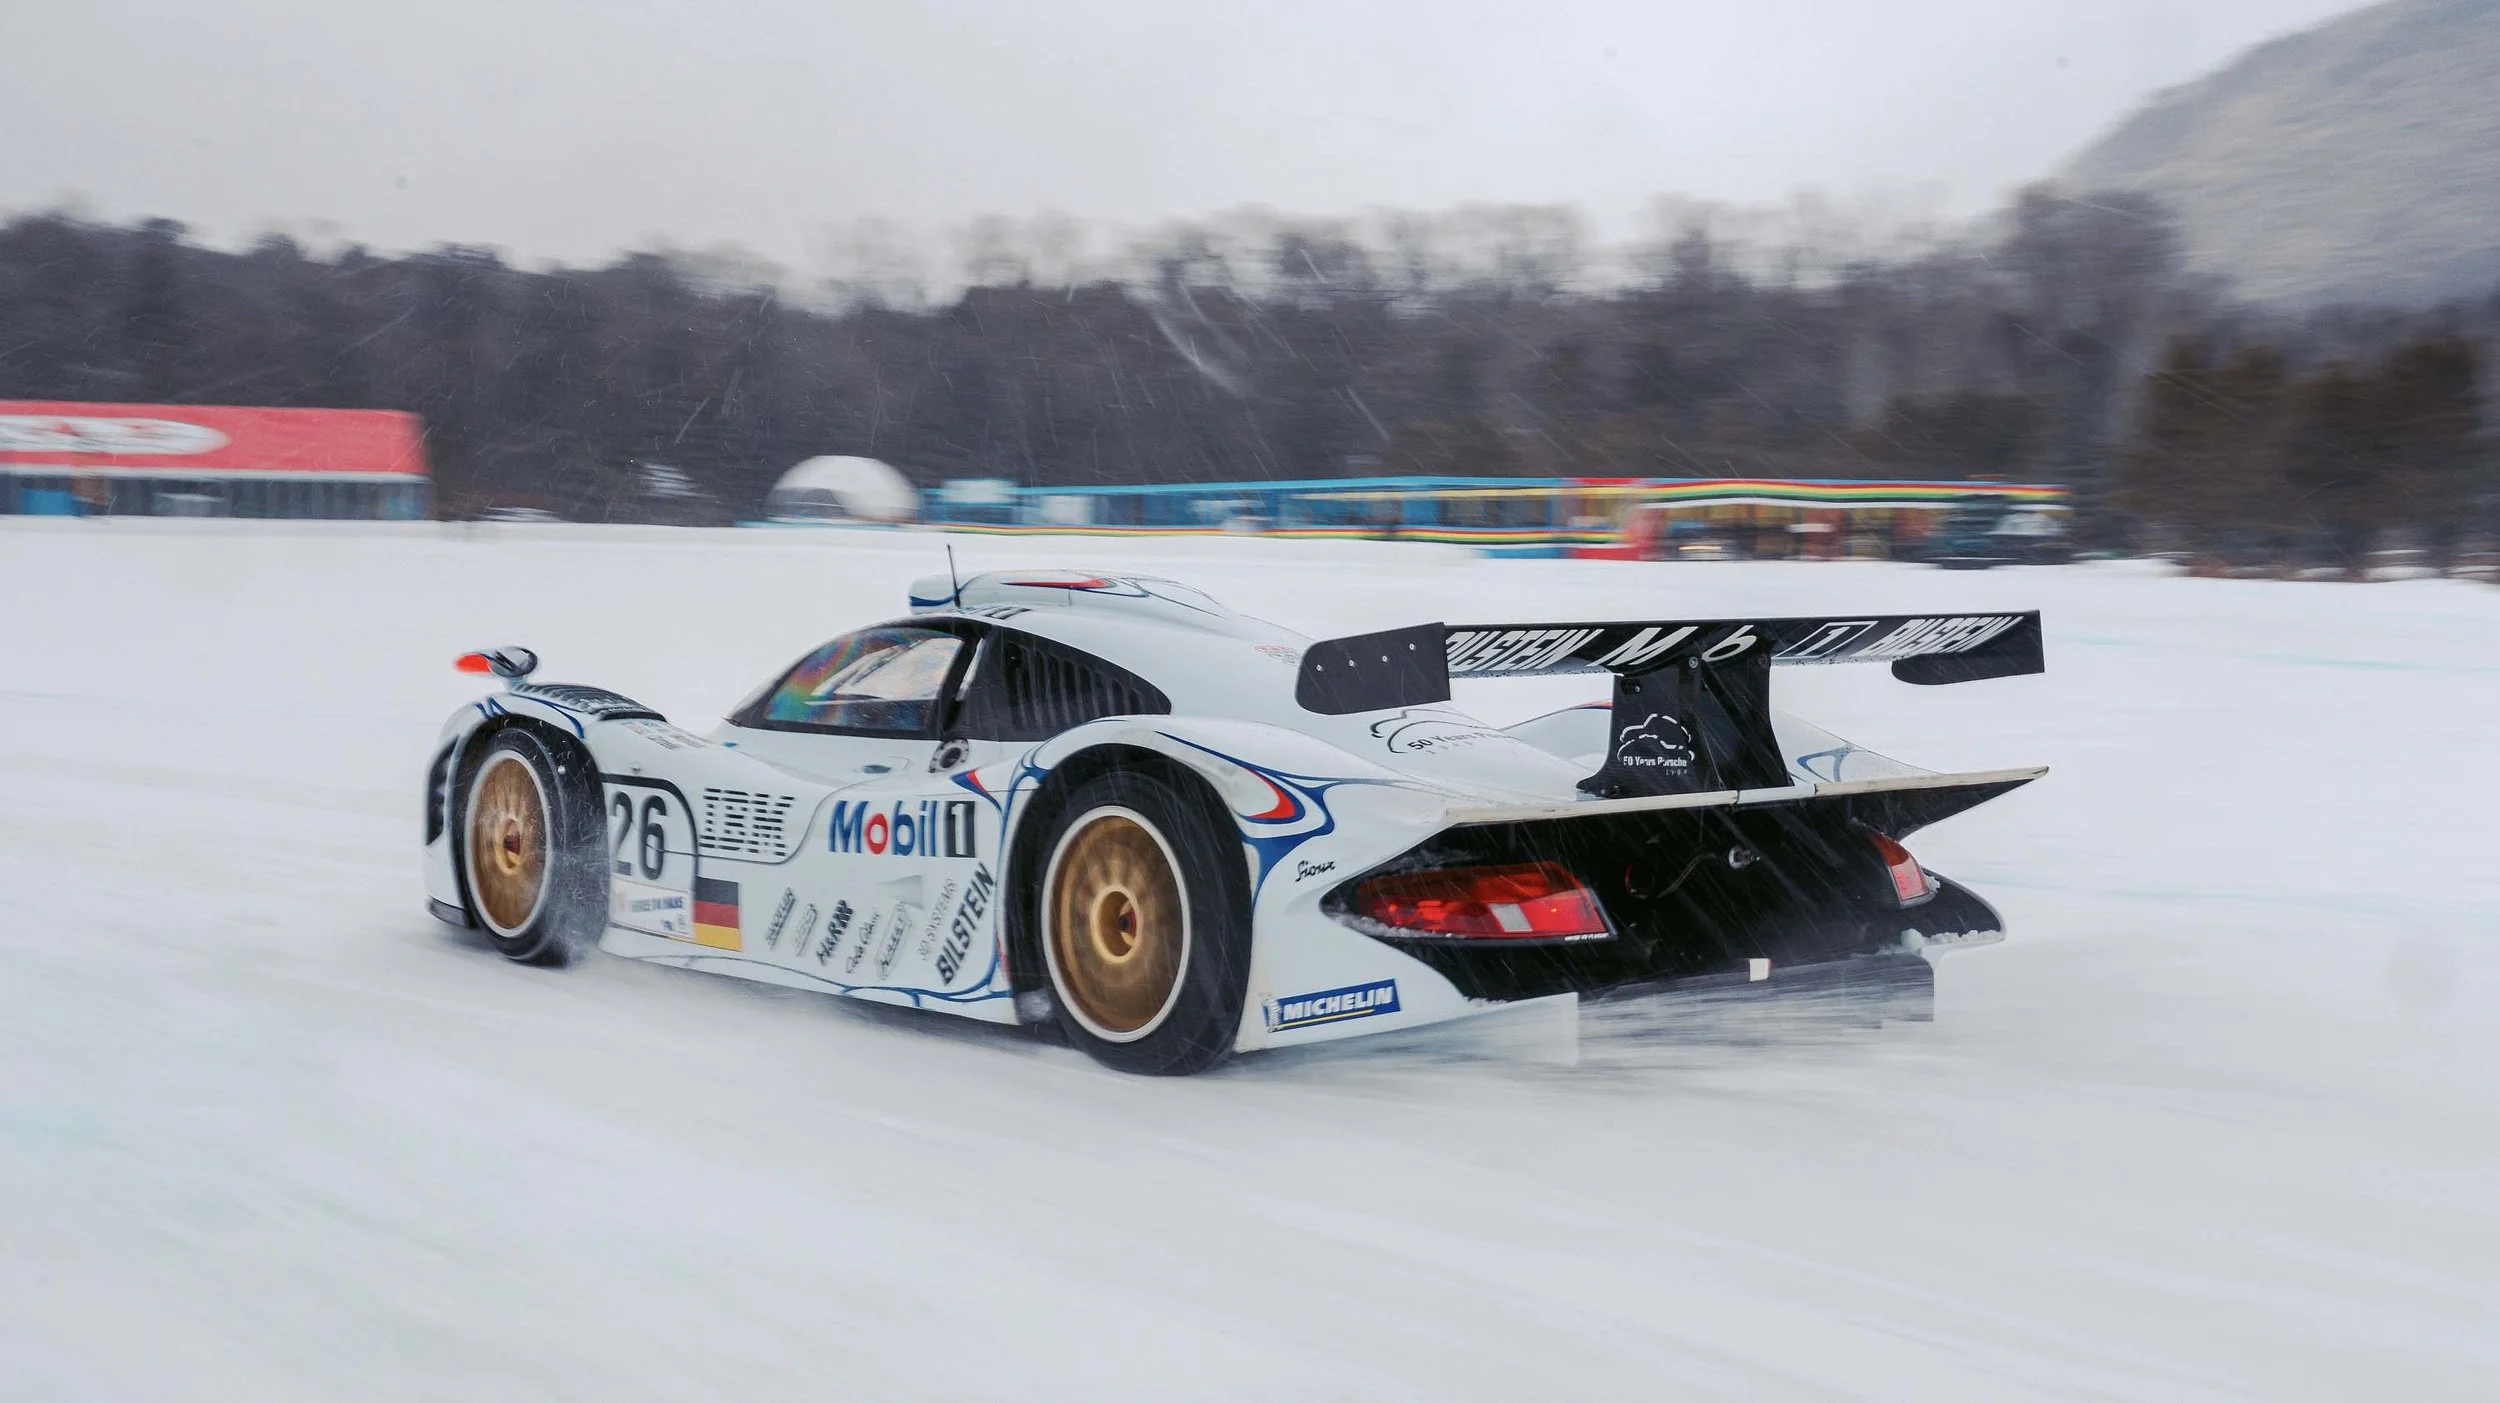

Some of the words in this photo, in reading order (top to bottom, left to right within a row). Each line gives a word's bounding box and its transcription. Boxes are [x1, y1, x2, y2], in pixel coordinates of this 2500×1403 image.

[1850, 616, 2024, 659] BILSTEIN
[1407, 739, 1433, 750] 50
[609, 791, 667, 880] 26
[699, 787, 795, 857] IBM
[829, 800, 938, 857] Mobil
[949, 801, 970, 857] 1
[935, 861, 995, 986] BILSTEIN
[1283, 986, 1394, 1020] MICHELIN
